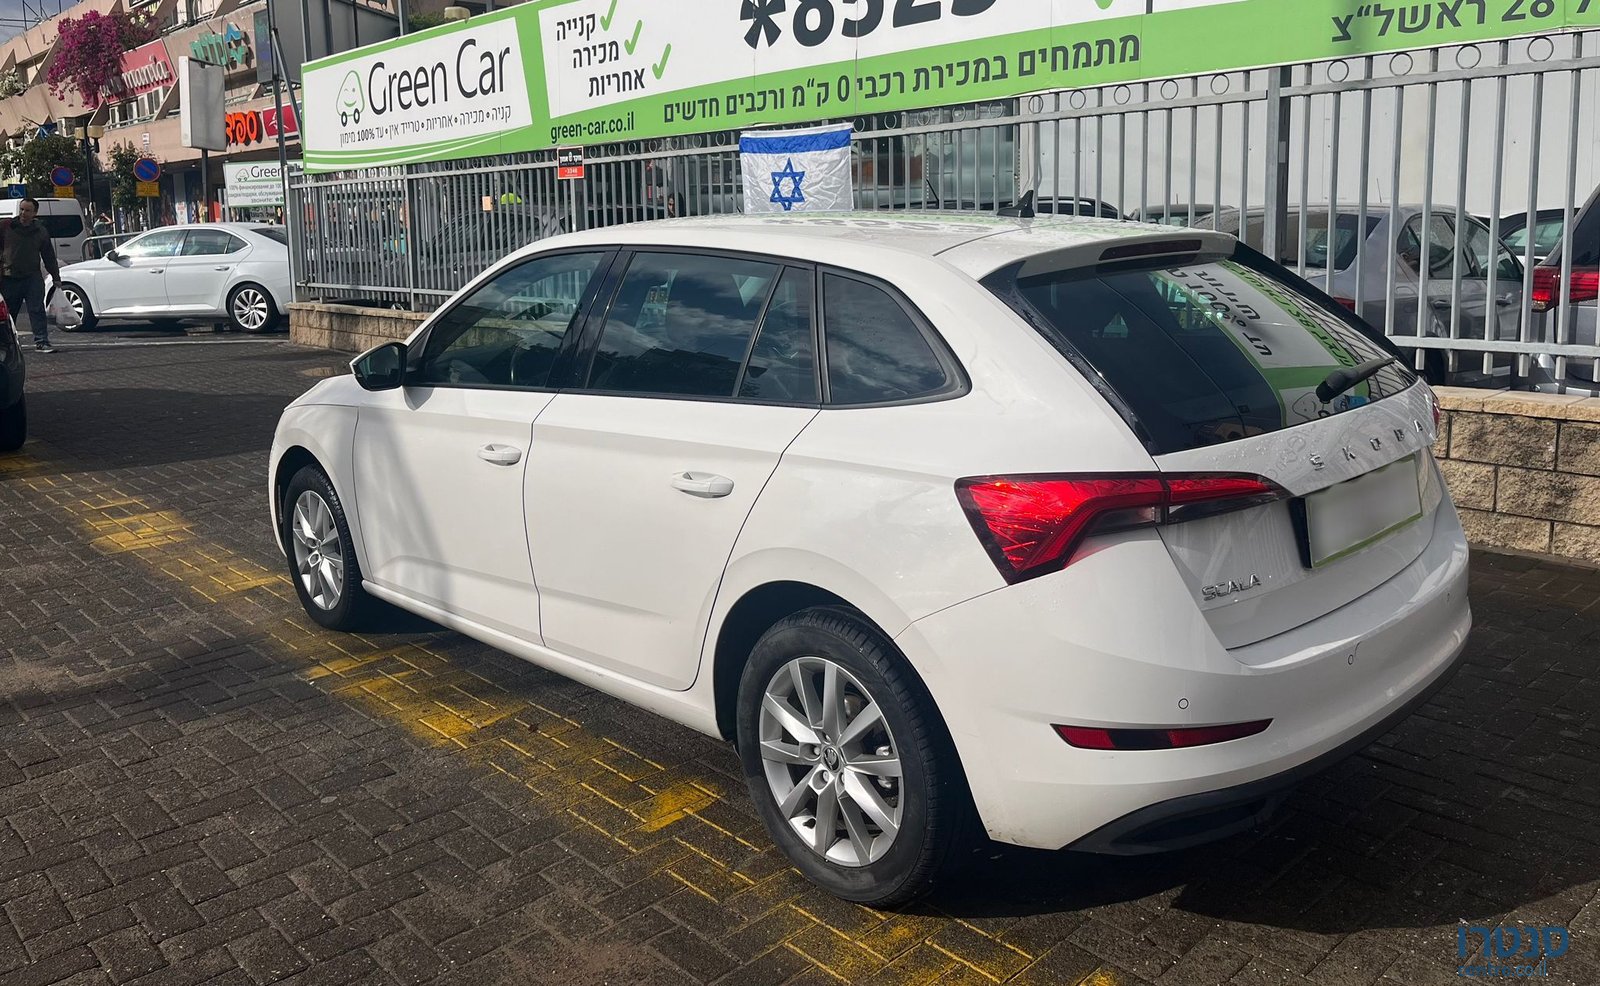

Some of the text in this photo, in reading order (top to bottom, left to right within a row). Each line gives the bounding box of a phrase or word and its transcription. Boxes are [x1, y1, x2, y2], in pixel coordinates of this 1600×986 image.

[556, 13, 596, 41] קנייה
[573, 40, 619, 68] מכירה
[1018, 34, 1140, 78] מתמחים
[368, 38, 510, 116] Green Car
[588, 68, 645, 97] אחריות
[856, 70, 905, 99] רכבי
[912, 55, 1008, 93] במכירת
[726, 87, 784, 115] ורכבים
[837, 75, 850, 102] 0
[426, 115, 453, 131] אחריות
[459, 109, 485, 126] מכירה
[491, 105, 511, 123] קניה
[664, 97, 720, 123] חדשים
[339, 131, 356, 147] מימון
[357, 128, 375, 142] 100%
[550, 111, 634, 144] green-car.co.il
[1201, 573, 1262, 601] SCALA
